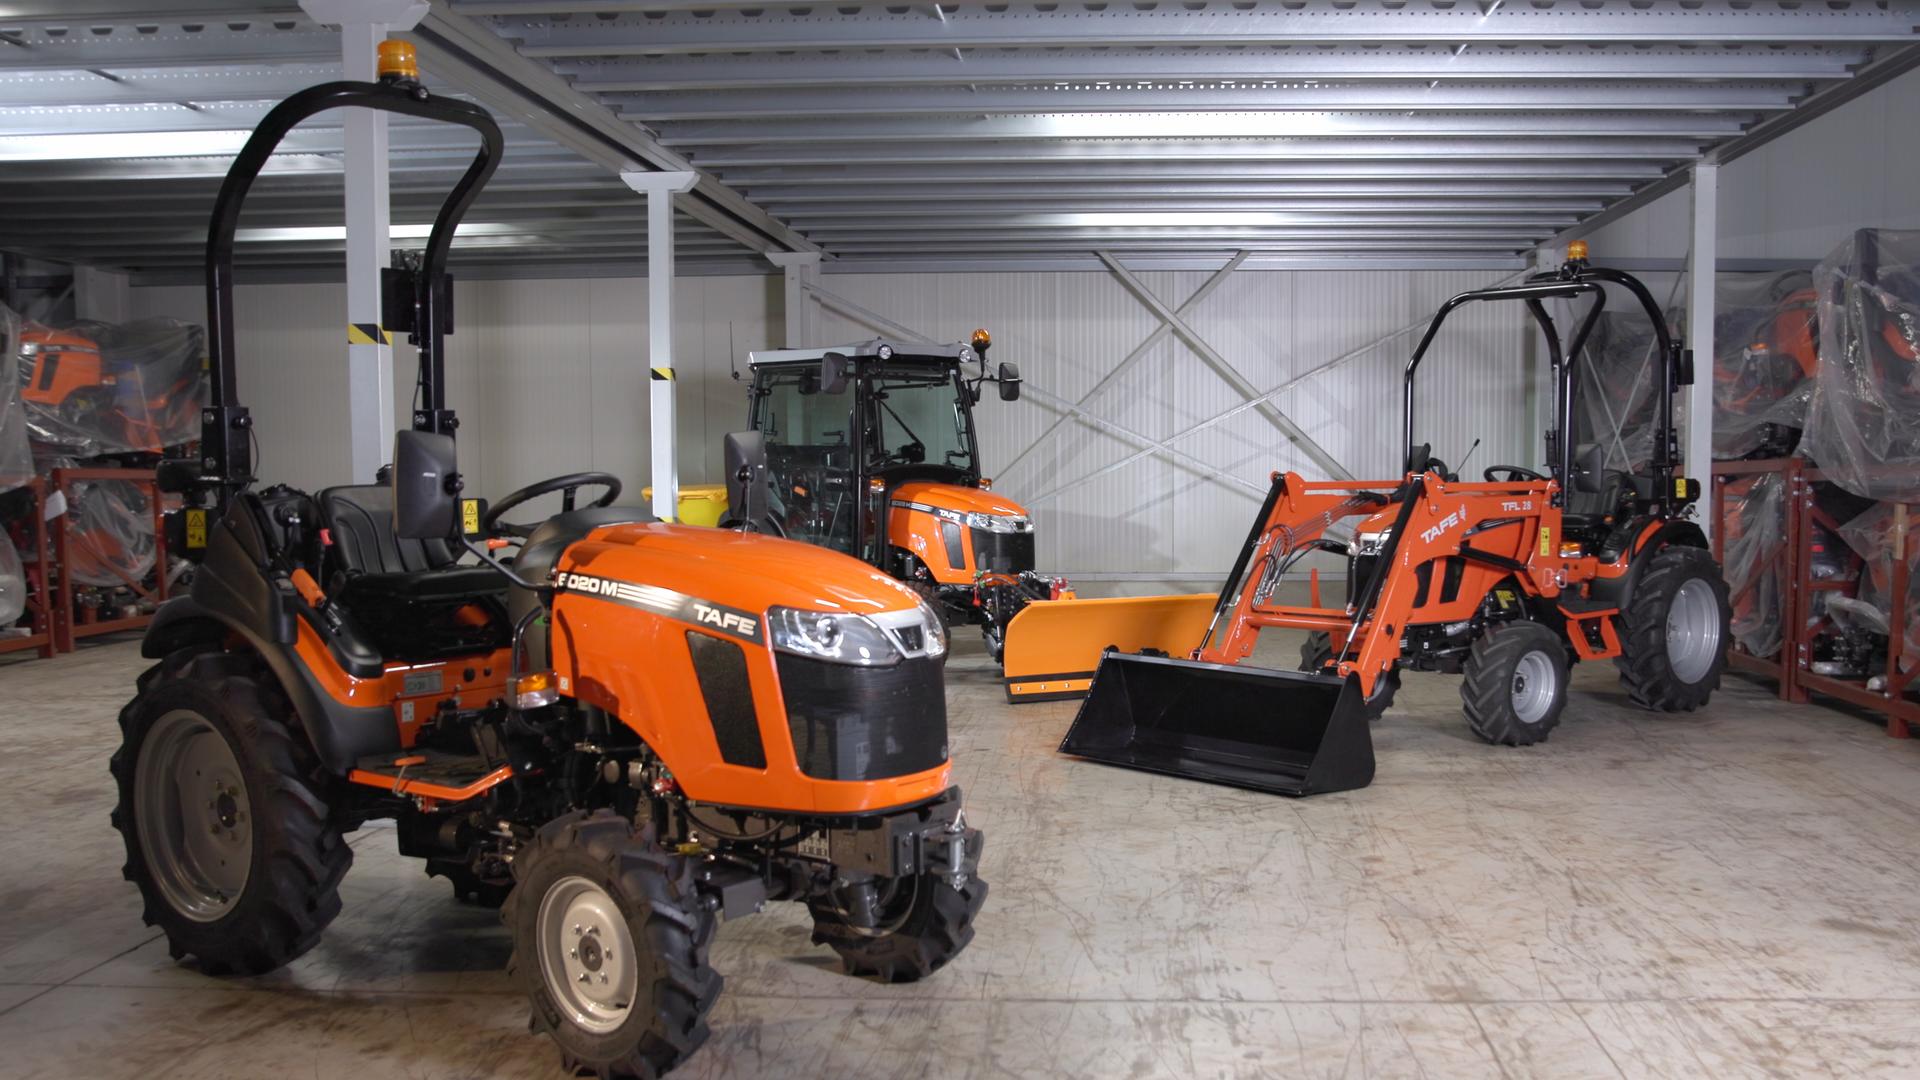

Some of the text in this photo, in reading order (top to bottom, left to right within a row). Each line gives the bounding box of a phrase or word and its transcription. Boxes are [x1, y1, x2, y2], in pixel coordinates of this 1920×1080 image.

[1501, 501, 1521, 511] TFL
[1420, 512, 1459, 544] TAFE
[693, 603, 757, 637] TAFE
